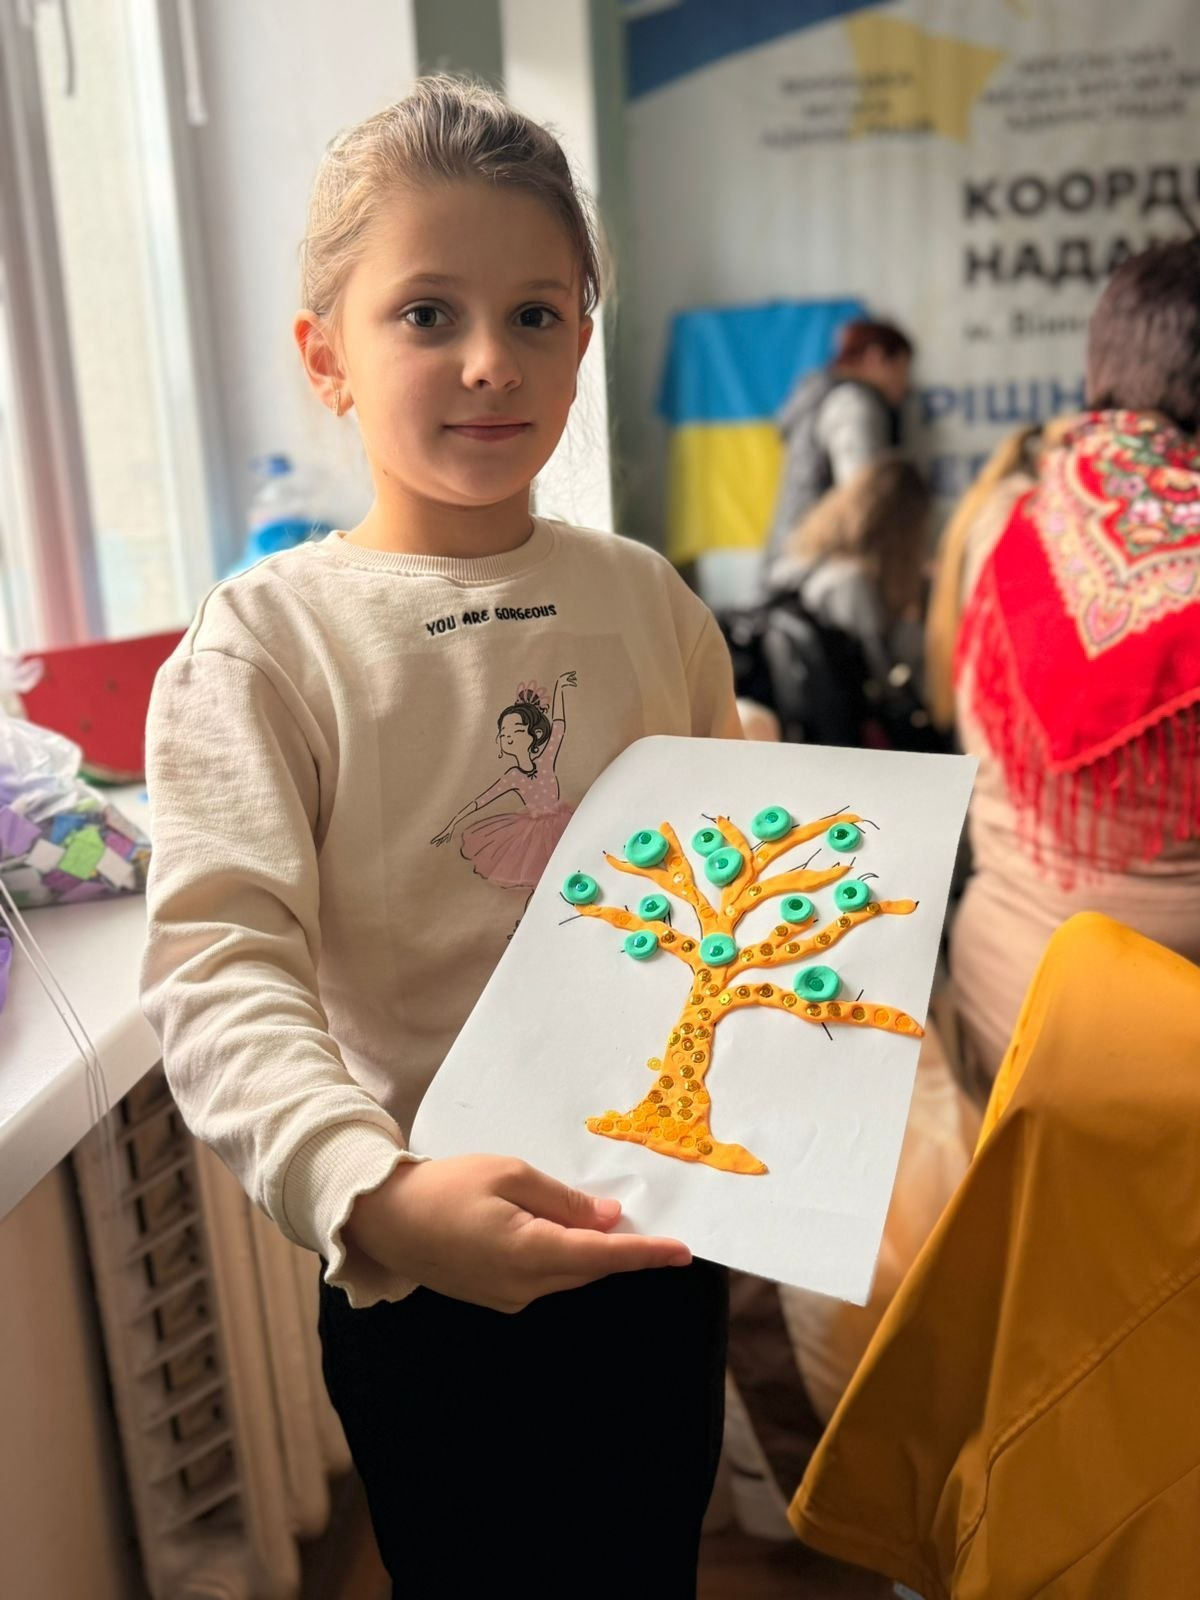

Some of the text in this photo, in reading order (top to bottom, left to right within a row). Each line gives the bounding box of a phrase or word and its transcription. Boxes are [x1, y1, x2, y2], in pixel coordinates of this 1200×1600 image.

[962, 163, 1200, 224] КООРД
[426, 604, 557, 637] YOU ARE GORGEOUS
